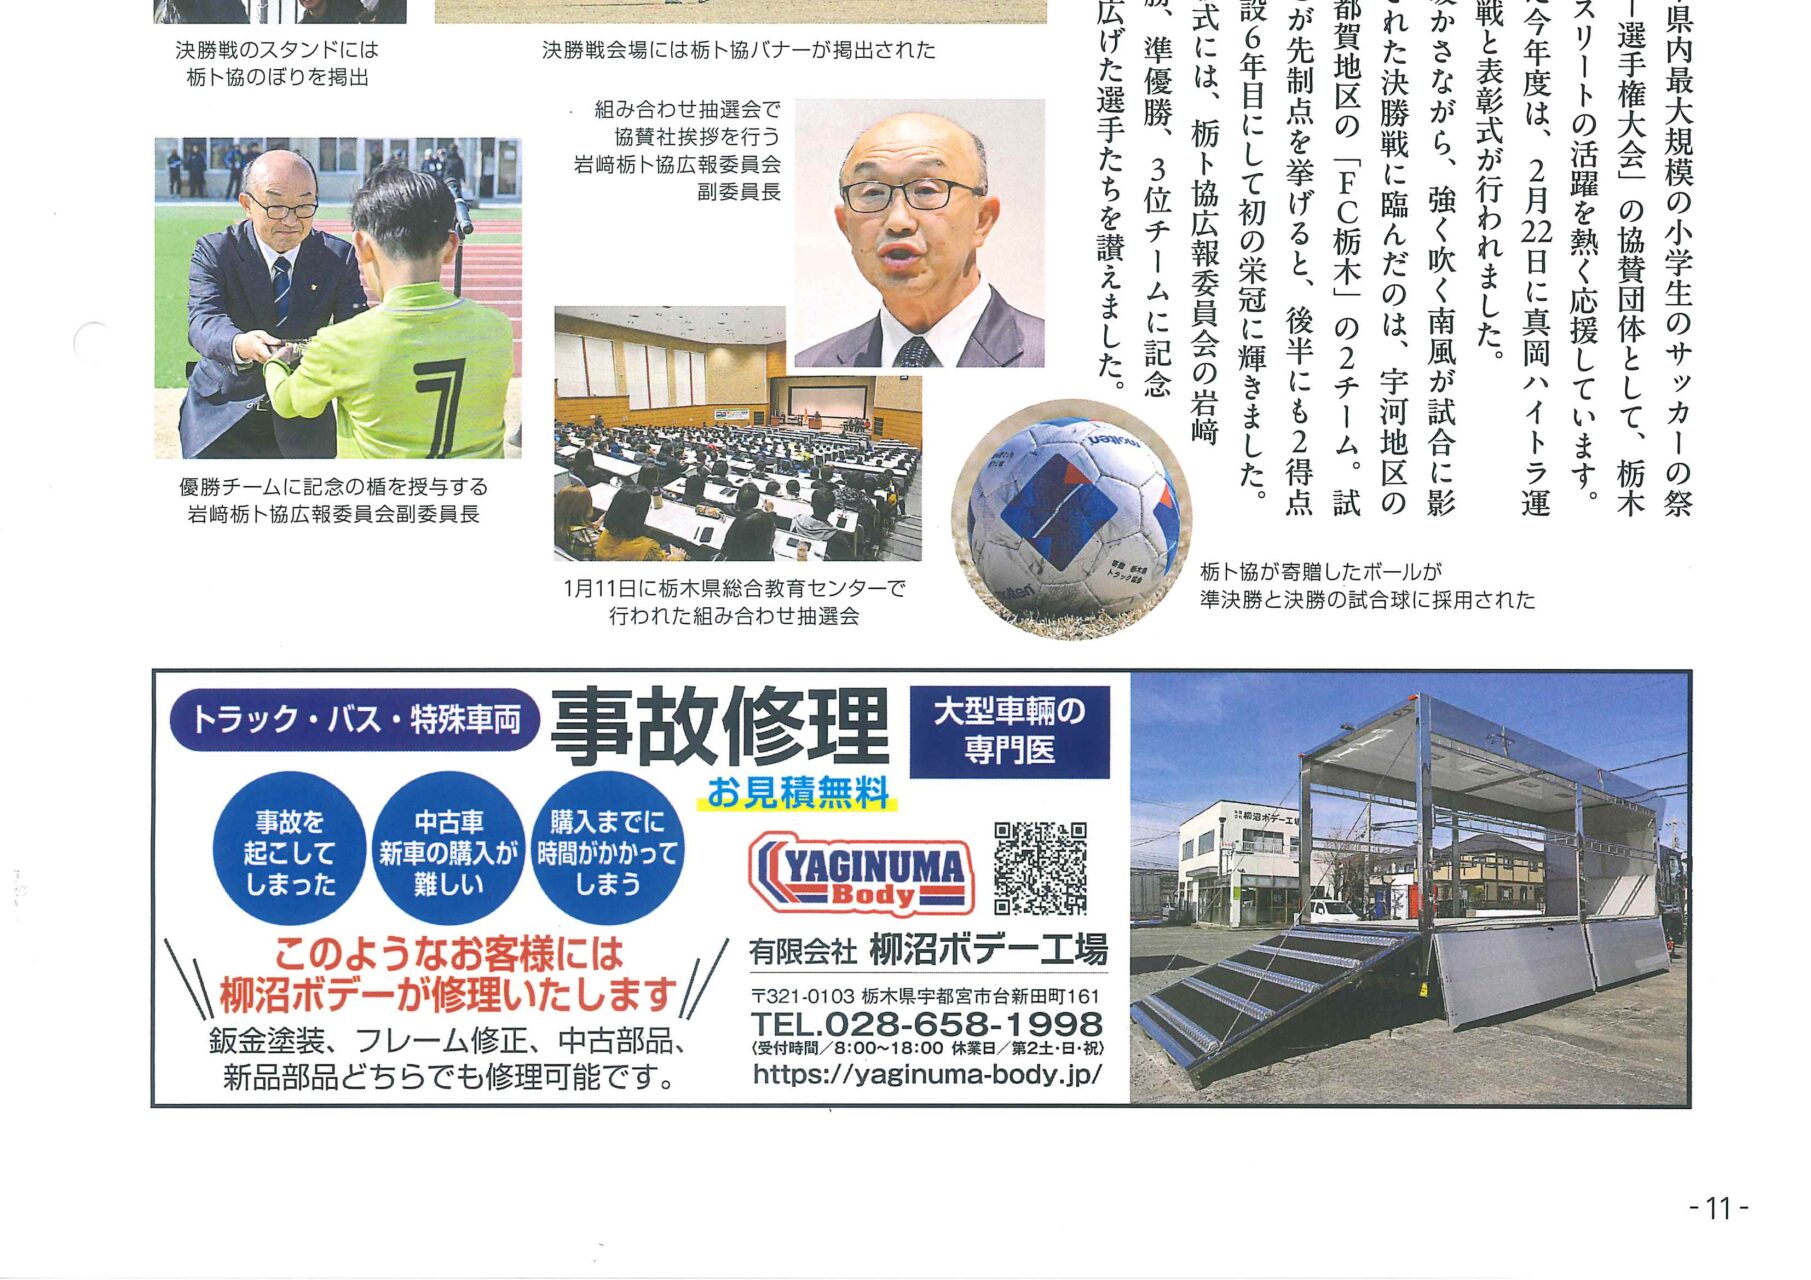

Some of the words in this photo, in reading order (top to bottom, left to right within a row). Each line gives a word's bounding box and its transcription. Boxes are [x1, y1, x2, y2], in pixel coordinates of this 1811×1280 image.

[176, 41, 378, 59] 決勝戦のスタンドには
[543, 41, 935, 59] 決勝戦会場には栃ト協バナーが掲出された
[187, 67, 367, 86] 栃ト協のぼりを掲出
[596, 100, 780, 119] 組み合わせ抽選会で
[615, 127, 778, 146] 協賛社挨拶を行う
[699, 183, 780, 201] 副委員長
[412, 357, 466, 459] 7
[180, 478, 487, 496] 優勝チームに記念の楯を授与する
[1201, 562, 1441, 581] 栃ト協が寄贈したボールが
[565, 579, 905, 598] 1月11日に栃木県総合教育センターで
[1201, 590, 1535, 609] 準決勝と決勝の試合球に採用された
[610, 607, 859, 625] 行われた組み合わせ抽選会
[197, 704, 520, 734] トラック・バス・特殊車両
[551, 685, 889, 766] 事故修理
[965, 735, 1055, 764] 専門医
[709, 775, 888, 808] お見積無料
[257, 810, 323, 834] 事故を
[416, 810, 483, 834] 中古車
[551, 810, 663, 834] 購入までに
[245, 841, 335, 865] 起こして
[380, 841, 517, 865] 新車の購入が
[538, 841, 677, 865] 時間がかかって
[786, 851, 963, 882] YAGINUMA
[248, 873, 335, 895] しまった
[415, 872, 482, 896] 難しい
[578, 873, 639, 895] しまう
[832, 884, 914, 908] Body
[277, 935, 622, 972] このようなお客様には
[750, 938, 857, 965] 有限会社
[870, 931, 1108, 965] 柳沼ボデー工場
[220, 976, 676, 1013] 柳沼ボデーが修理いたします
[752, 989, 854, 1004] 〒321-0103
[862, 987, 1097, 1005] 栃木県宇都宮市台新田町161
[751, 1012, 1102, 1037] TEL.028-658-1998
[210, 1026, 683, 1054] 鈑金塗装、フレーム修正、中古部品、
[224, 1063, 670, 1090] 新品部品どちらでも修理可能です。
[755, 1064, 1102, 1087] https://yaginuma-body.jp/
